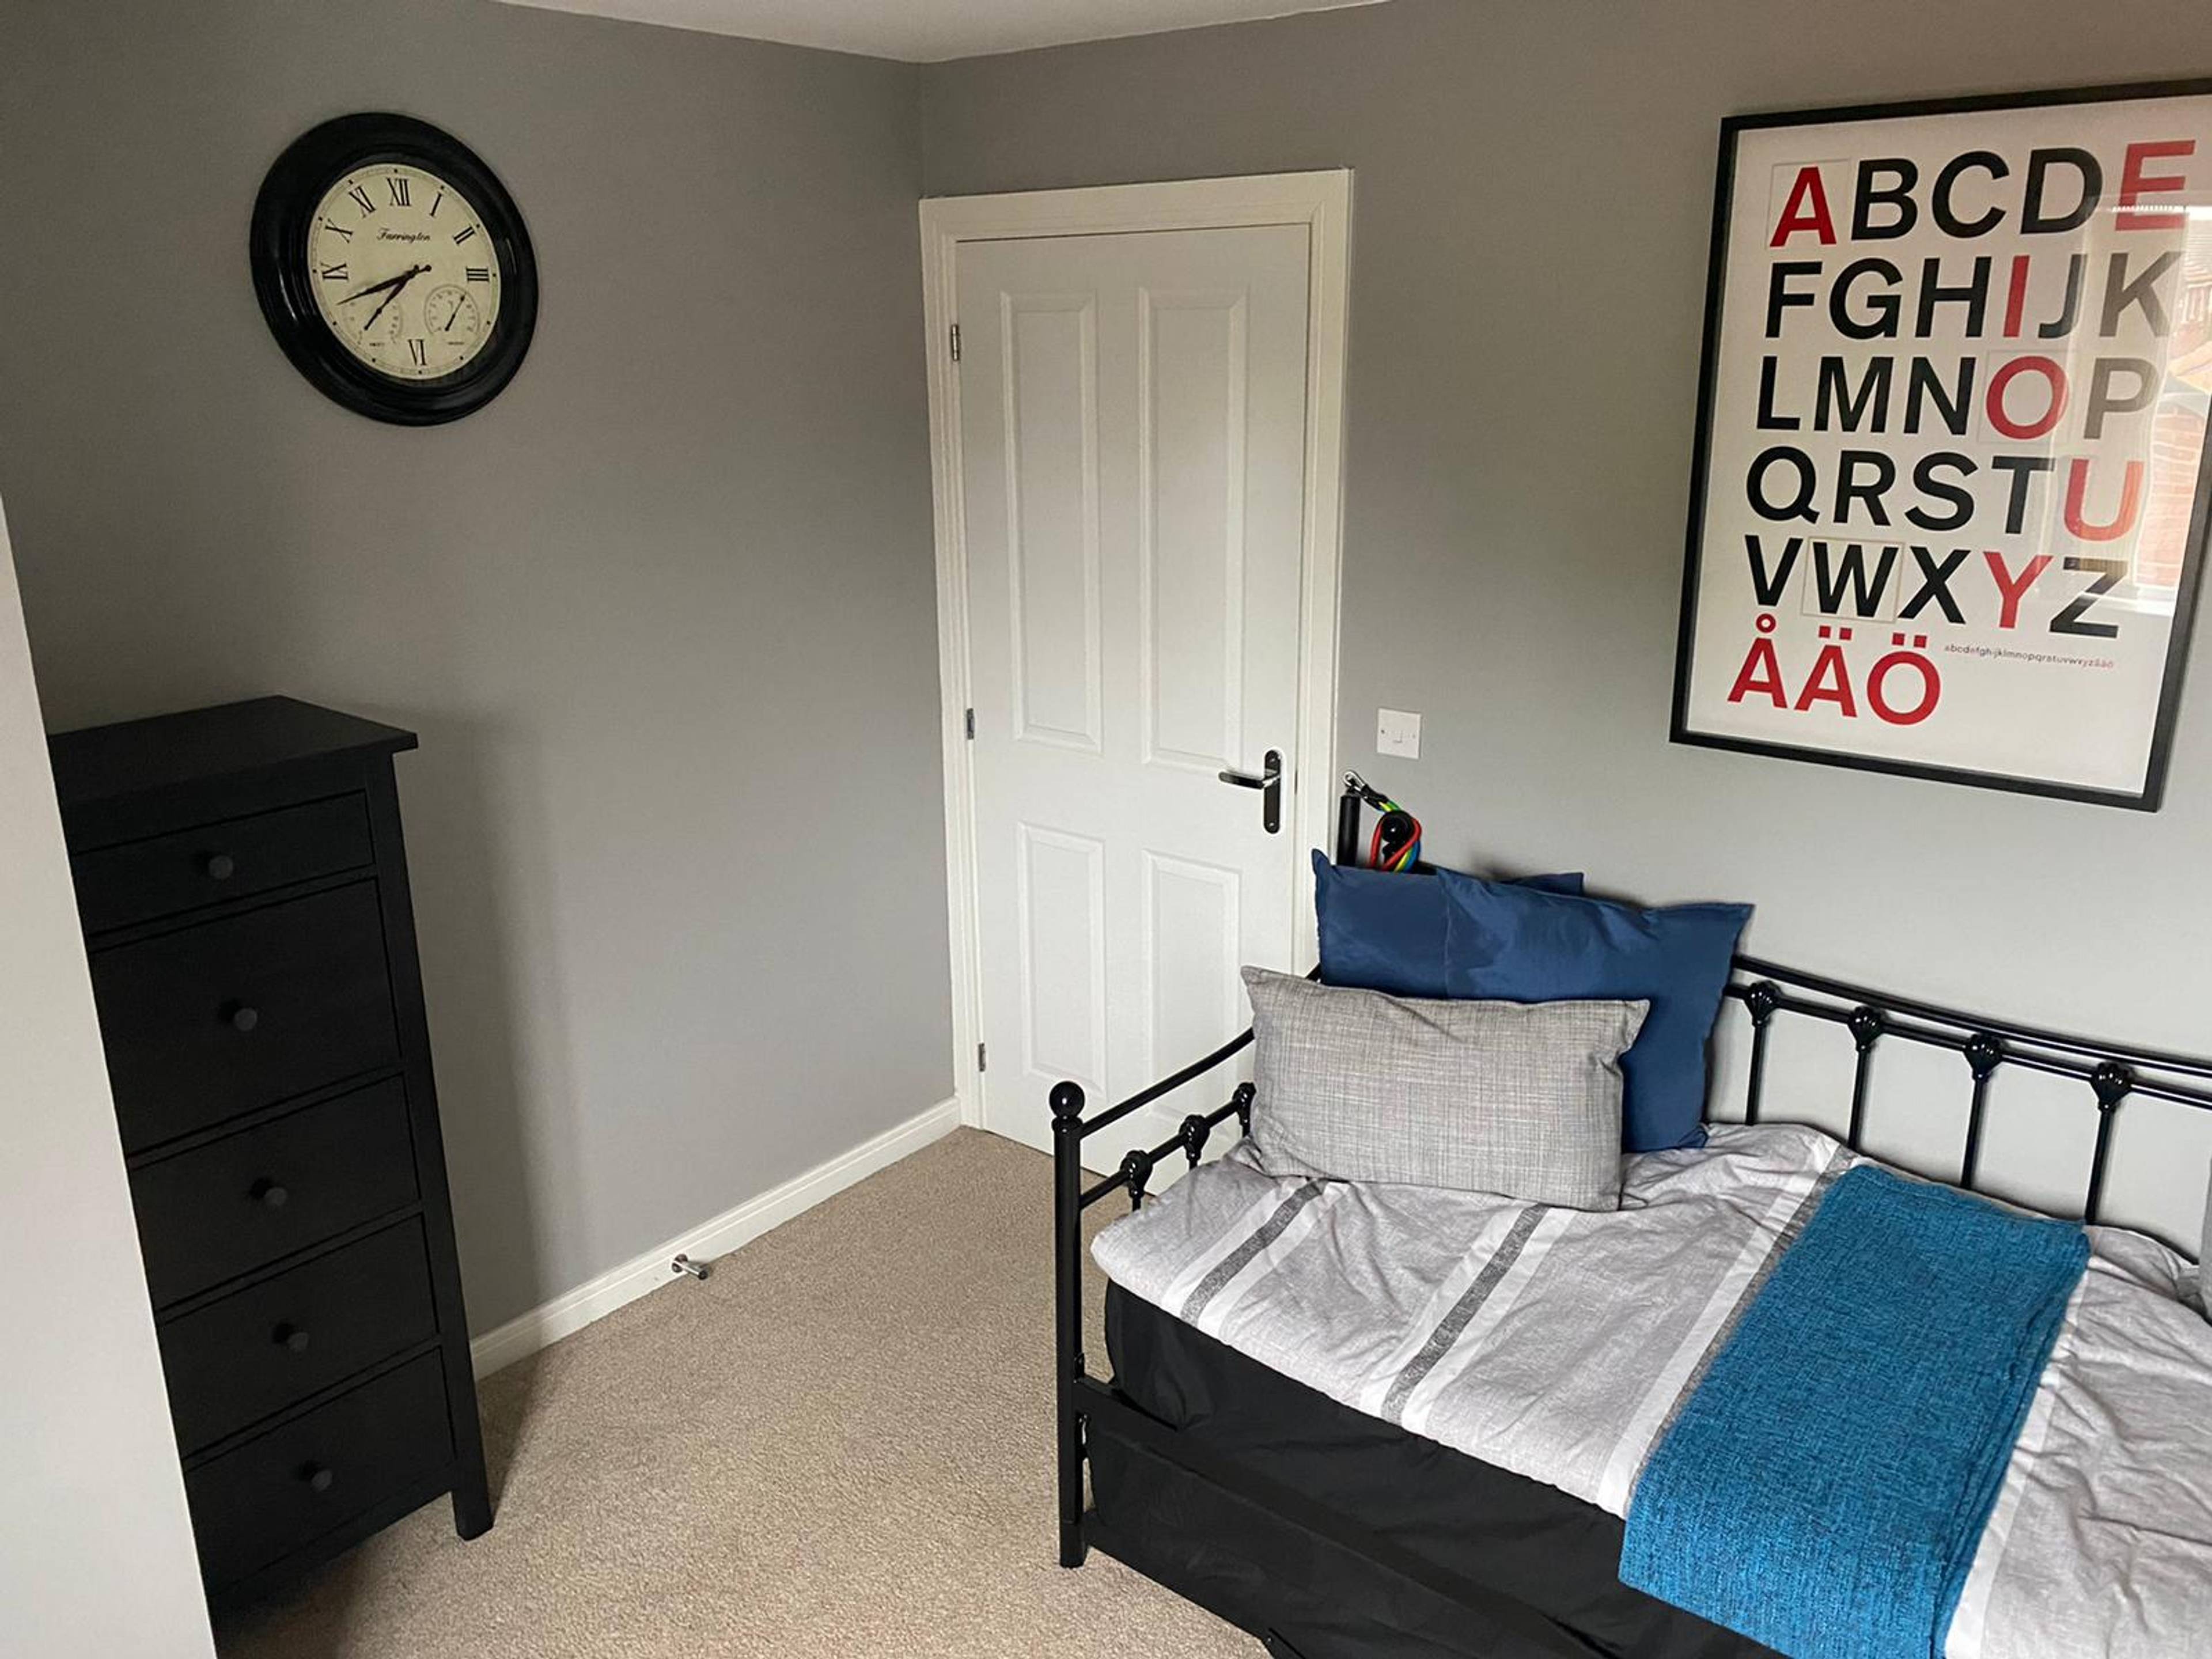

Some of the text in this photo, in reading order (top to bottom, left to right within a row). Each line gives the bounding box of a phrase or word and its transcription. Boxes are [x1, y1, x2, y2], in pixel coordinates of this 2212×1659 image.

[349, 186, 376, 218] XI
[387, 178, 412, 206] XII
[1769, 139, 2196, 247] ABCDE
[325, 218, 353, 243] X
[376, 227, 431, 243] Farrington
[320, 262, 349, 280] IX
[1764, 251, 2186, 340] FGHIJK
[407, 339, 427, 366] VI
[1756, 354, 2160, 440] LMNOP
[1745, 446, 2144, 541] QRSTU
[1744, 535, 2129, 639] VWXYZ
[1727, 613, 1941, 726] ÅÄÖ
